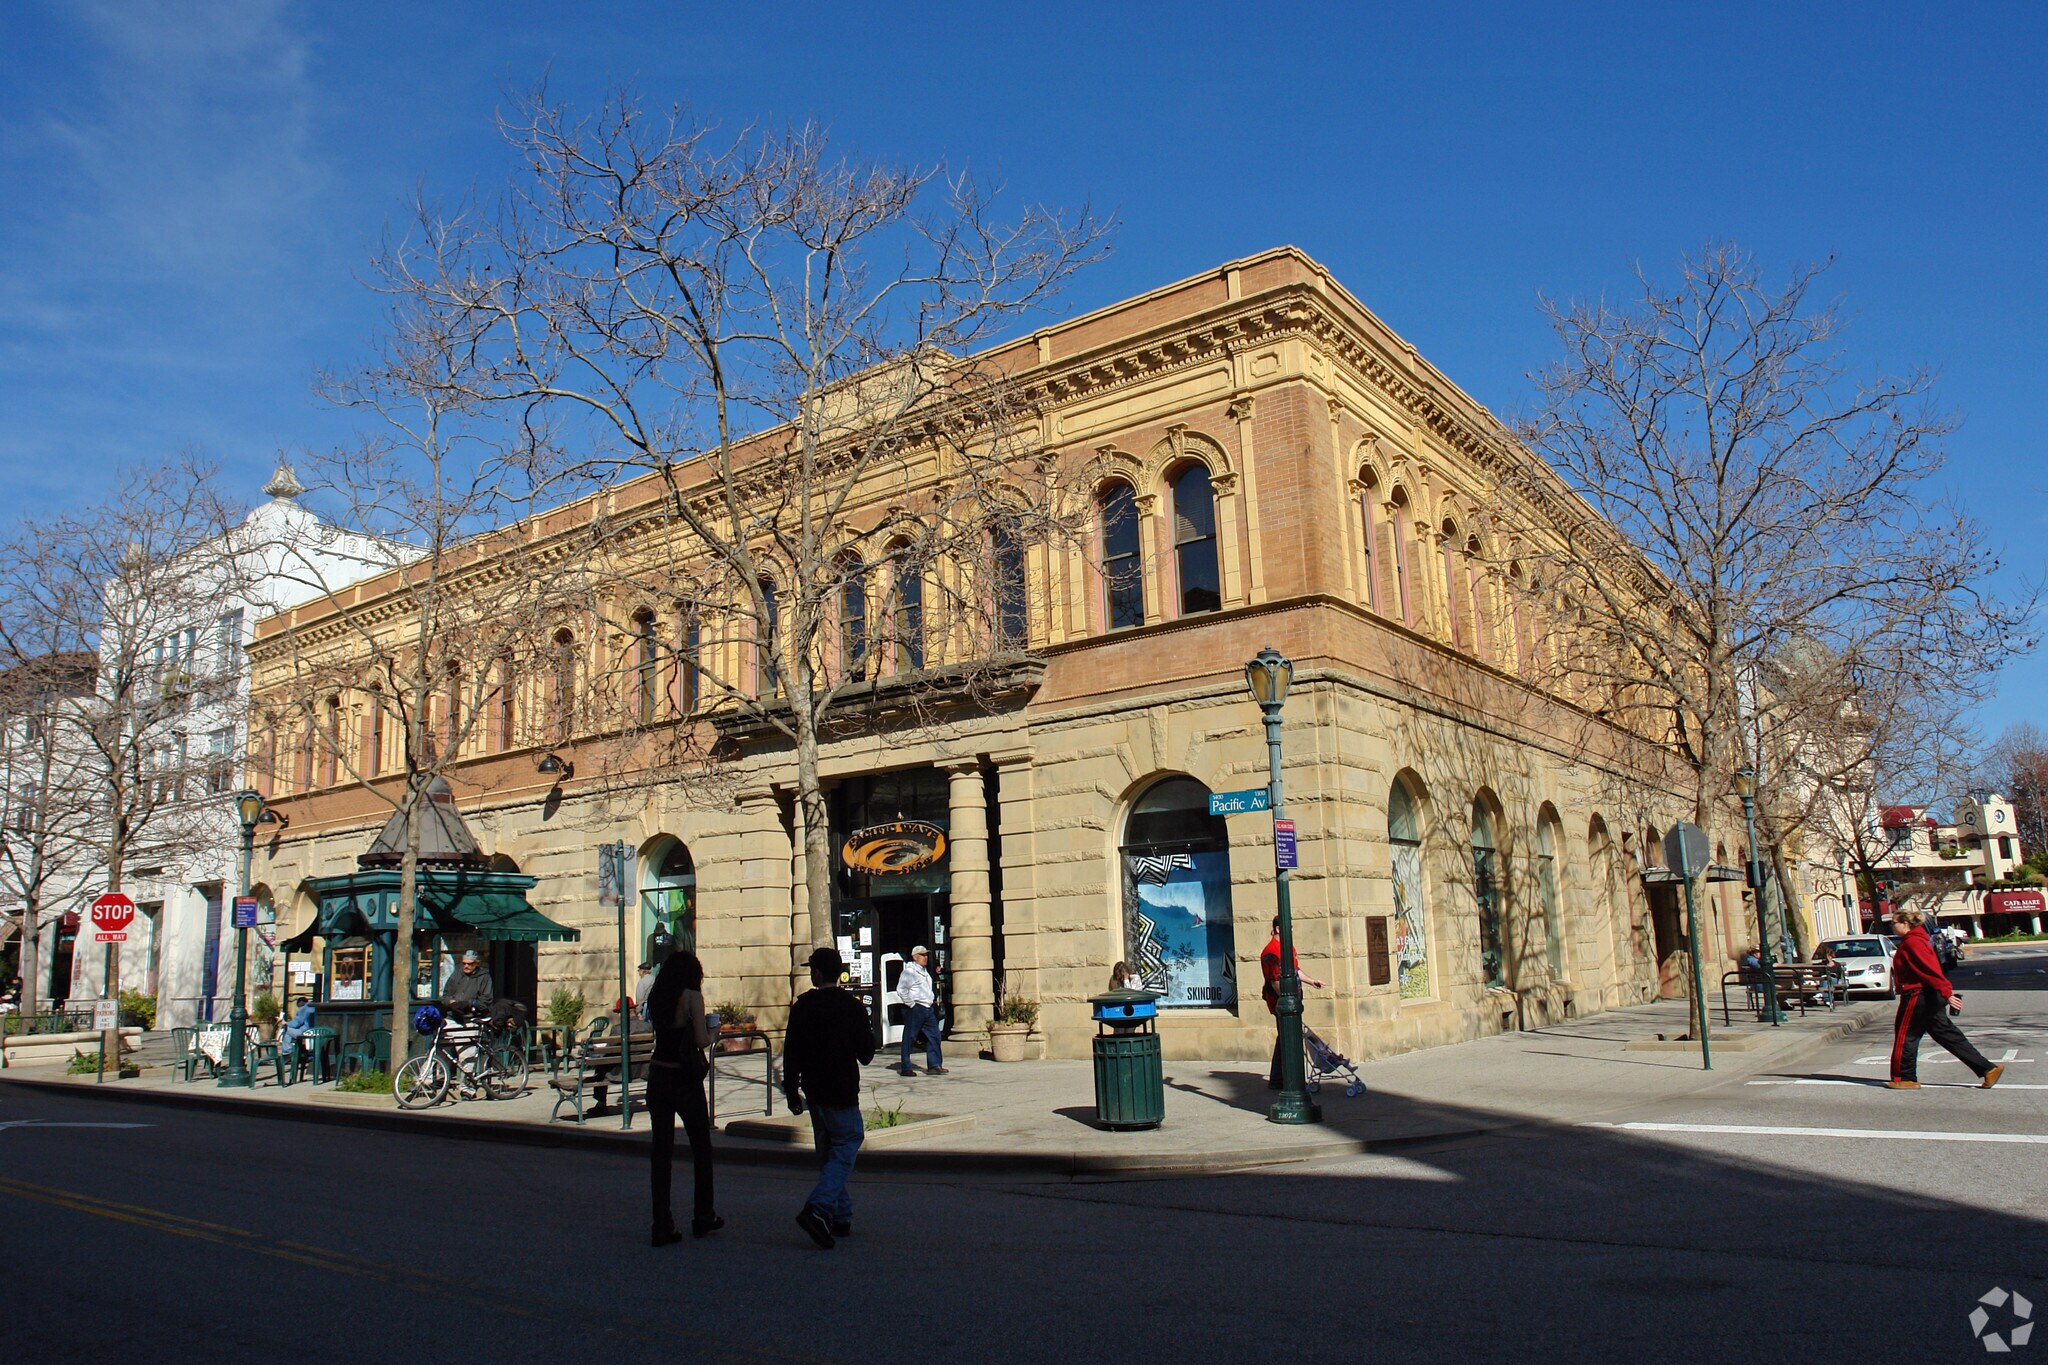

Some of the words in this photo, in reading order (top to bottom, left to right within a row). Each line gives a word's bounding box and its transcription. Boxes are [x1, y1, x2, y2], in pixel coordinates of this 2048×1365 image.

[1212, 798, 1245, 812] Pacific
[1250, 797, 1266, 809] Av
[849, 824, 897, 847] PACIFIC
[900, 823, 938, 839] WAVE
[853, 862, 882, 876] SURF
[901, 855, 934, 873] SNOW
[93, 905, 133, 920] STOP
[1187, 986, 1222, 1001] SKINDOG
